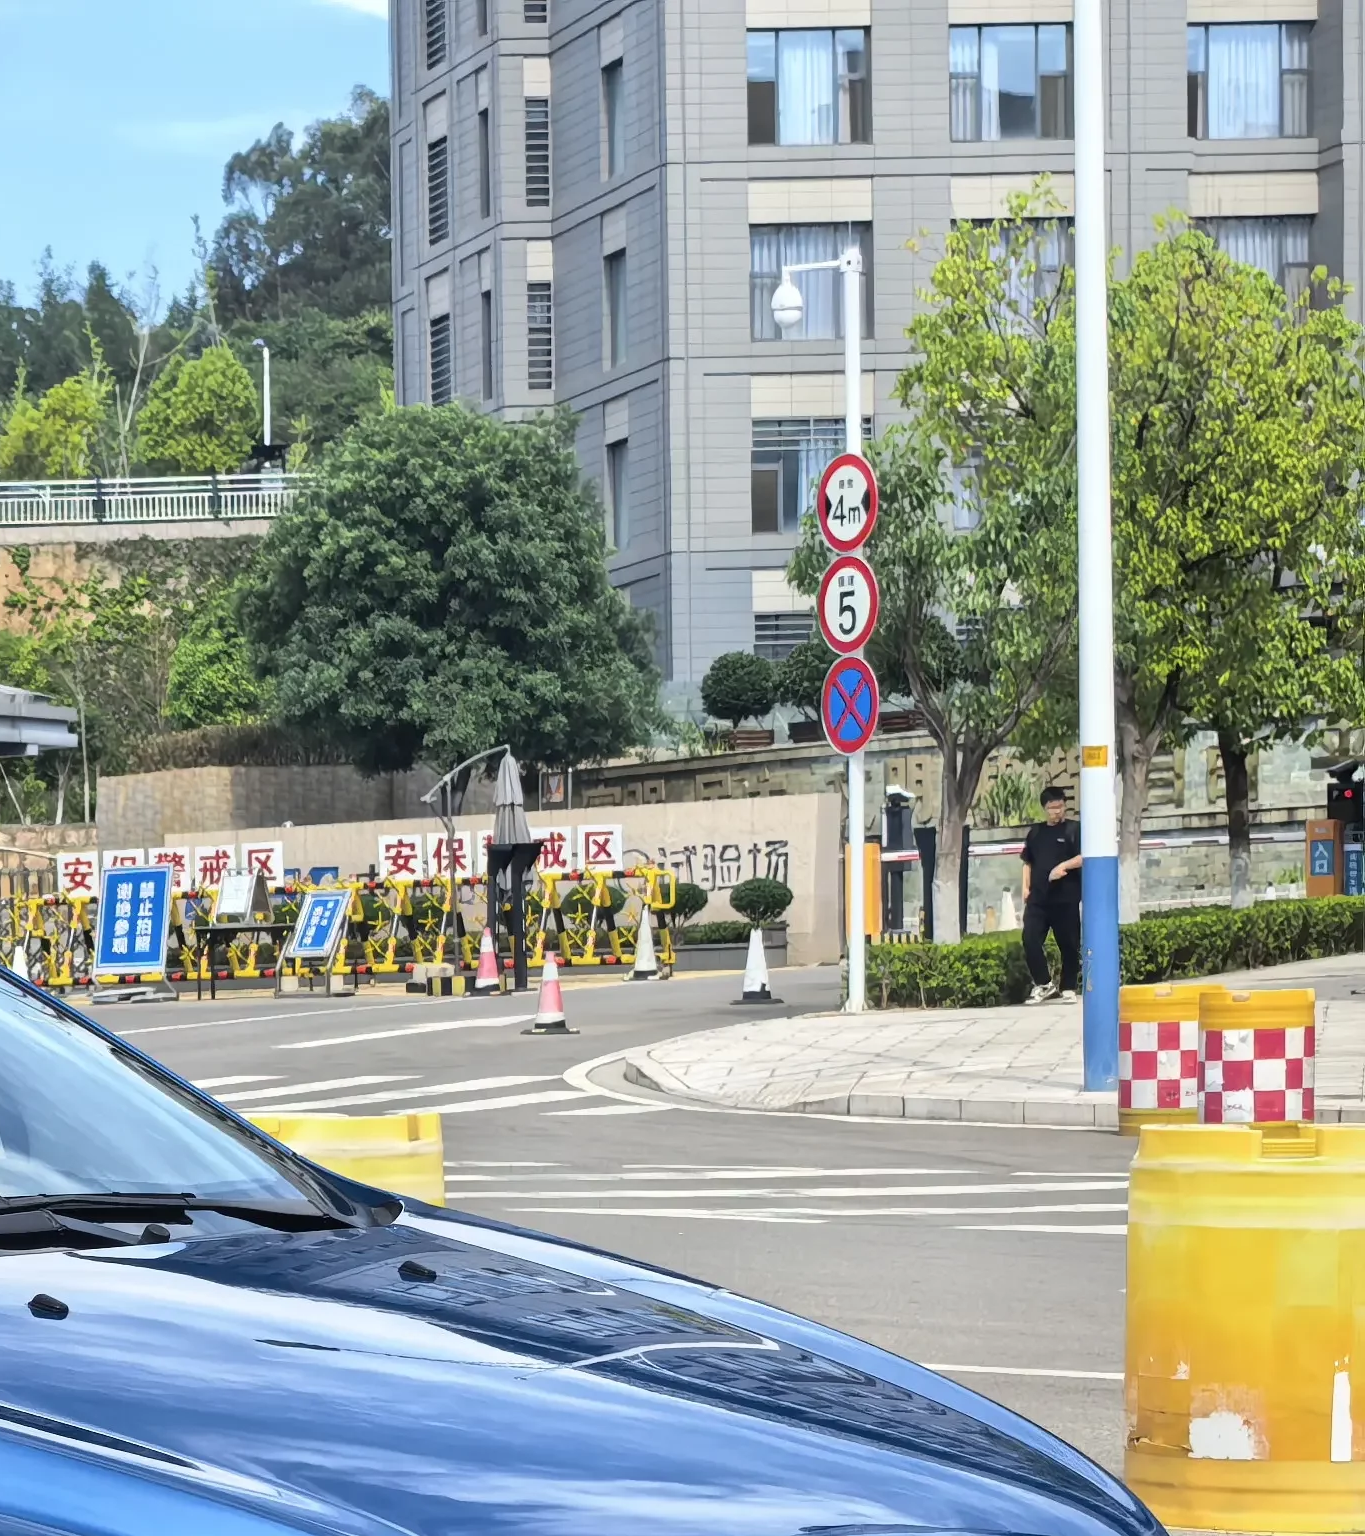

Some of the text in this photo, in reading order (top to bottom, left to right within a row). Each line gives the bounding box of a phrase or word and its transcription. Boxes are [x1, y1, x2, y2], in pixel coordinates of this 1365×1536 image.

[832, 494, 861, 527] 4m
[838, 590, 857, 635] 5
[384, 830, 617, 876] 安保戒区
[1314, 841, 1329, 874] 入口
